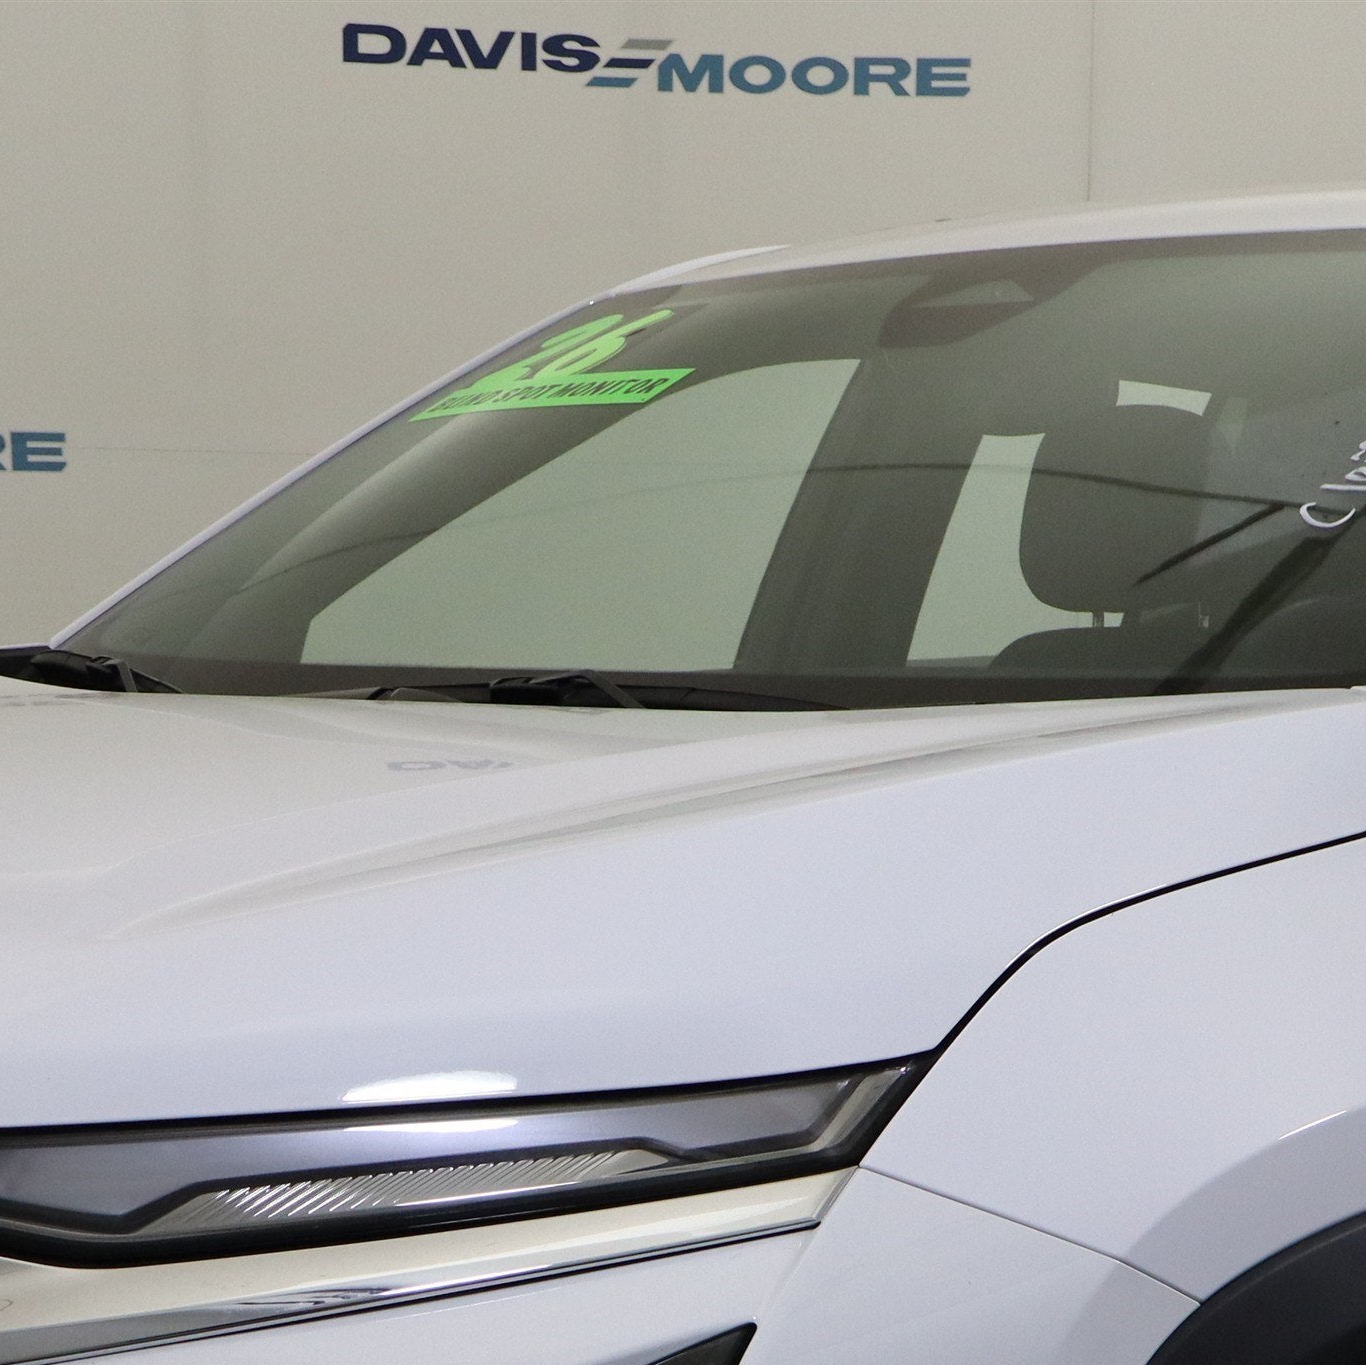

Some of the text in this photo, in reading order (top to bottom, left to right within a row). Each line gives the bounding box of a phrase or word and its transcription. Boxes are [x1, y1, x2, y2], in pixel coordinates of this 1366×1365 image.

[342, 23, 971, 98] DAVIS MOORE
[491, 382, 563, 404] SPOT
[546, 377, 672, 399] MONITOR
